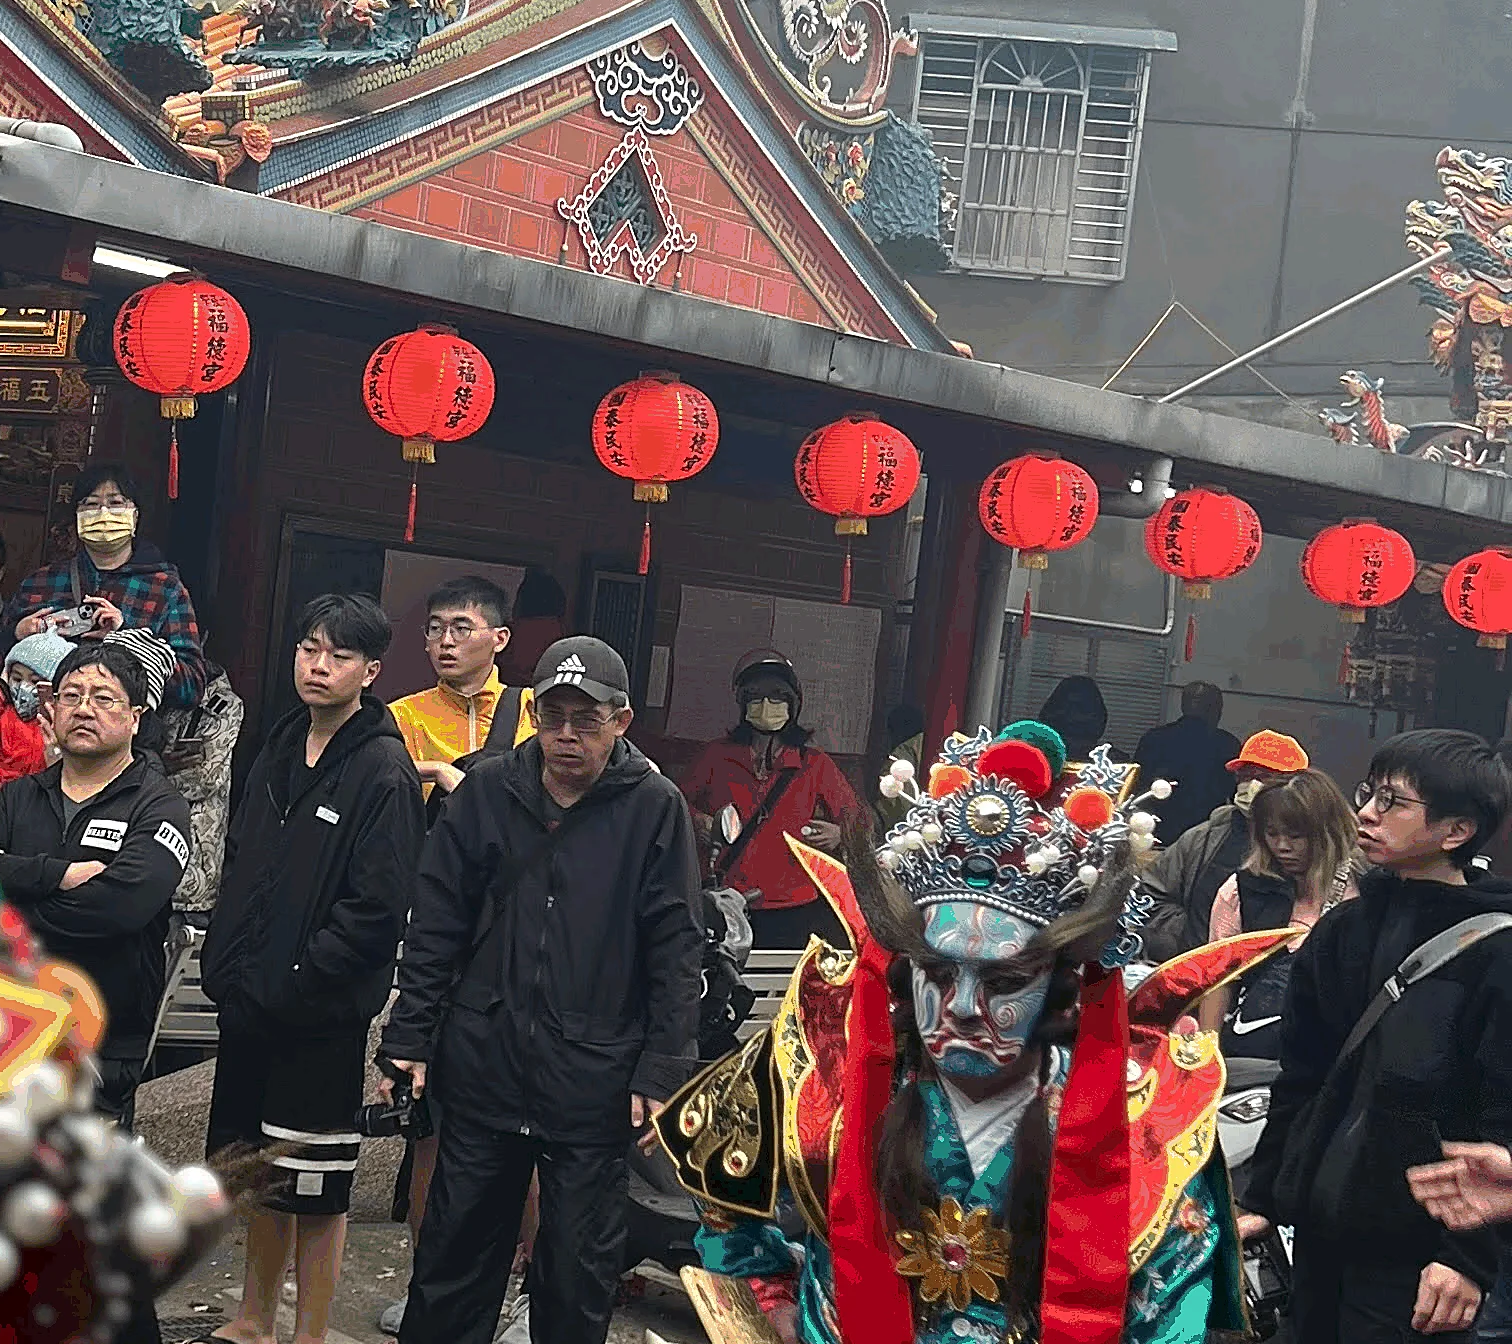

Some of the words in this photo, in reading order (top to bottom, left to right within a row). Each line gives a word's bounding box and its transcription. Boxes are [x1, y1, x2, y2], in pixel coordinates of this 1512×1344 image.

[200, 308, 229, 383] 福德宮
[444, 358, 477, 429] 福德宮
[603, 391, 630, 468] 國泰民安
[680, 407, 710, 472] 福德宮
[868, 446, 898, 508] 福德宮
[987, 466, 1012, 536] 國泰民安
[1059, 481, 1088, 542] 福德宮
[1164, 500, 1191, 568] 國泰民安
[1356, 550, 1383, 601] 福德宮
[1458, 562, 1483, 625] 國泰民安
